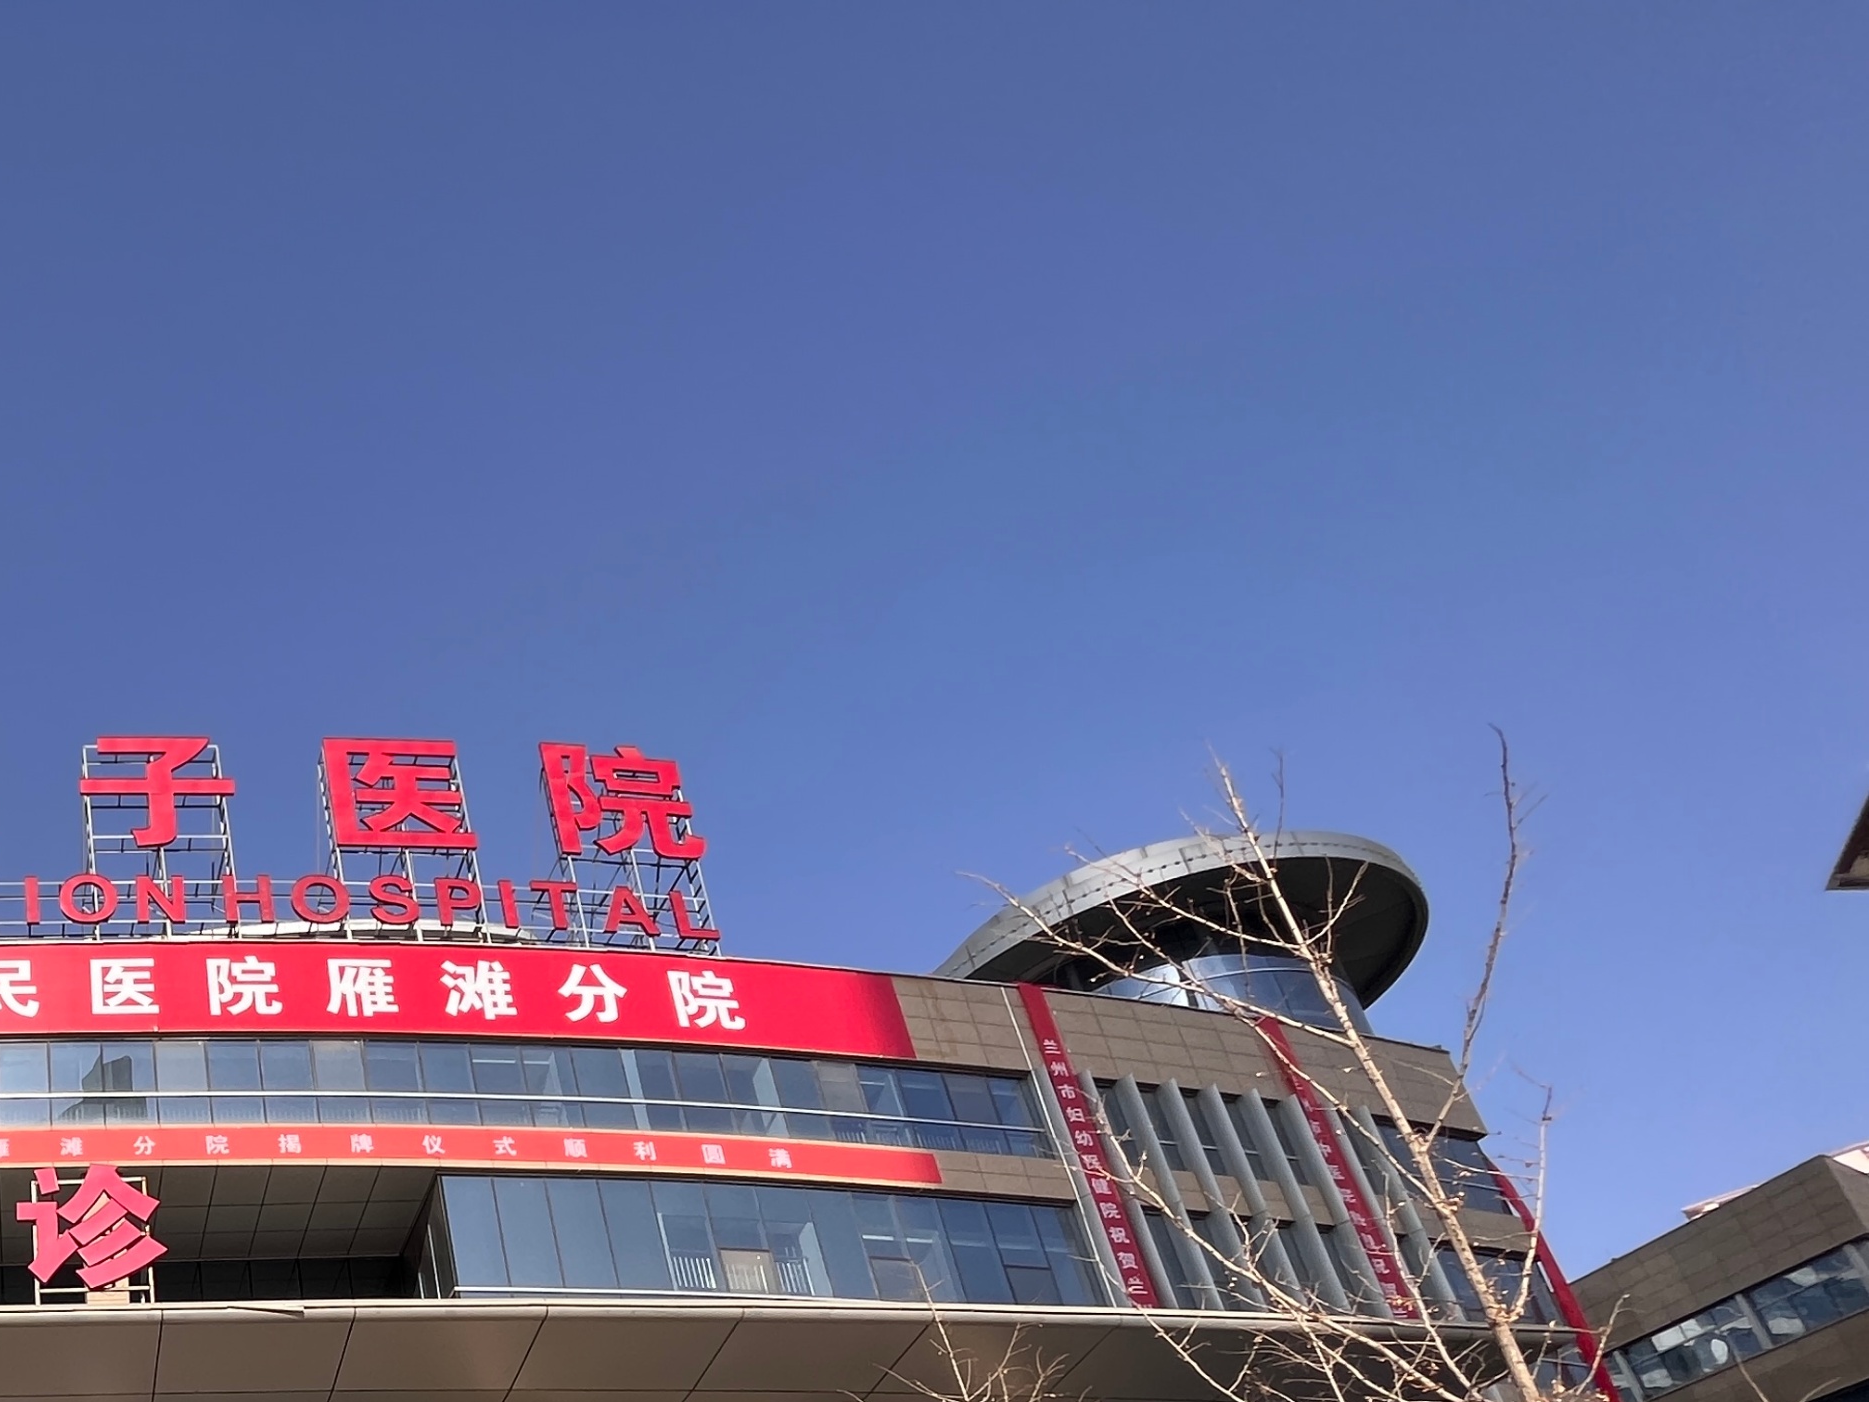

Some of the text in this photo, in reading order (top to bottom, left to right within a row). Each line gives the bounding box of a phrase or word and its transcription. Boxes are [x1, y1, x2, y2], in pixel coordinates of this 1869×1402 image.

[24, 874, 186, 926] ION
[222, 873, 722, 942] HOSPITAL
[1042, 1038, 1154, 1309] 兰州市妇幼保健院祝贺兰
